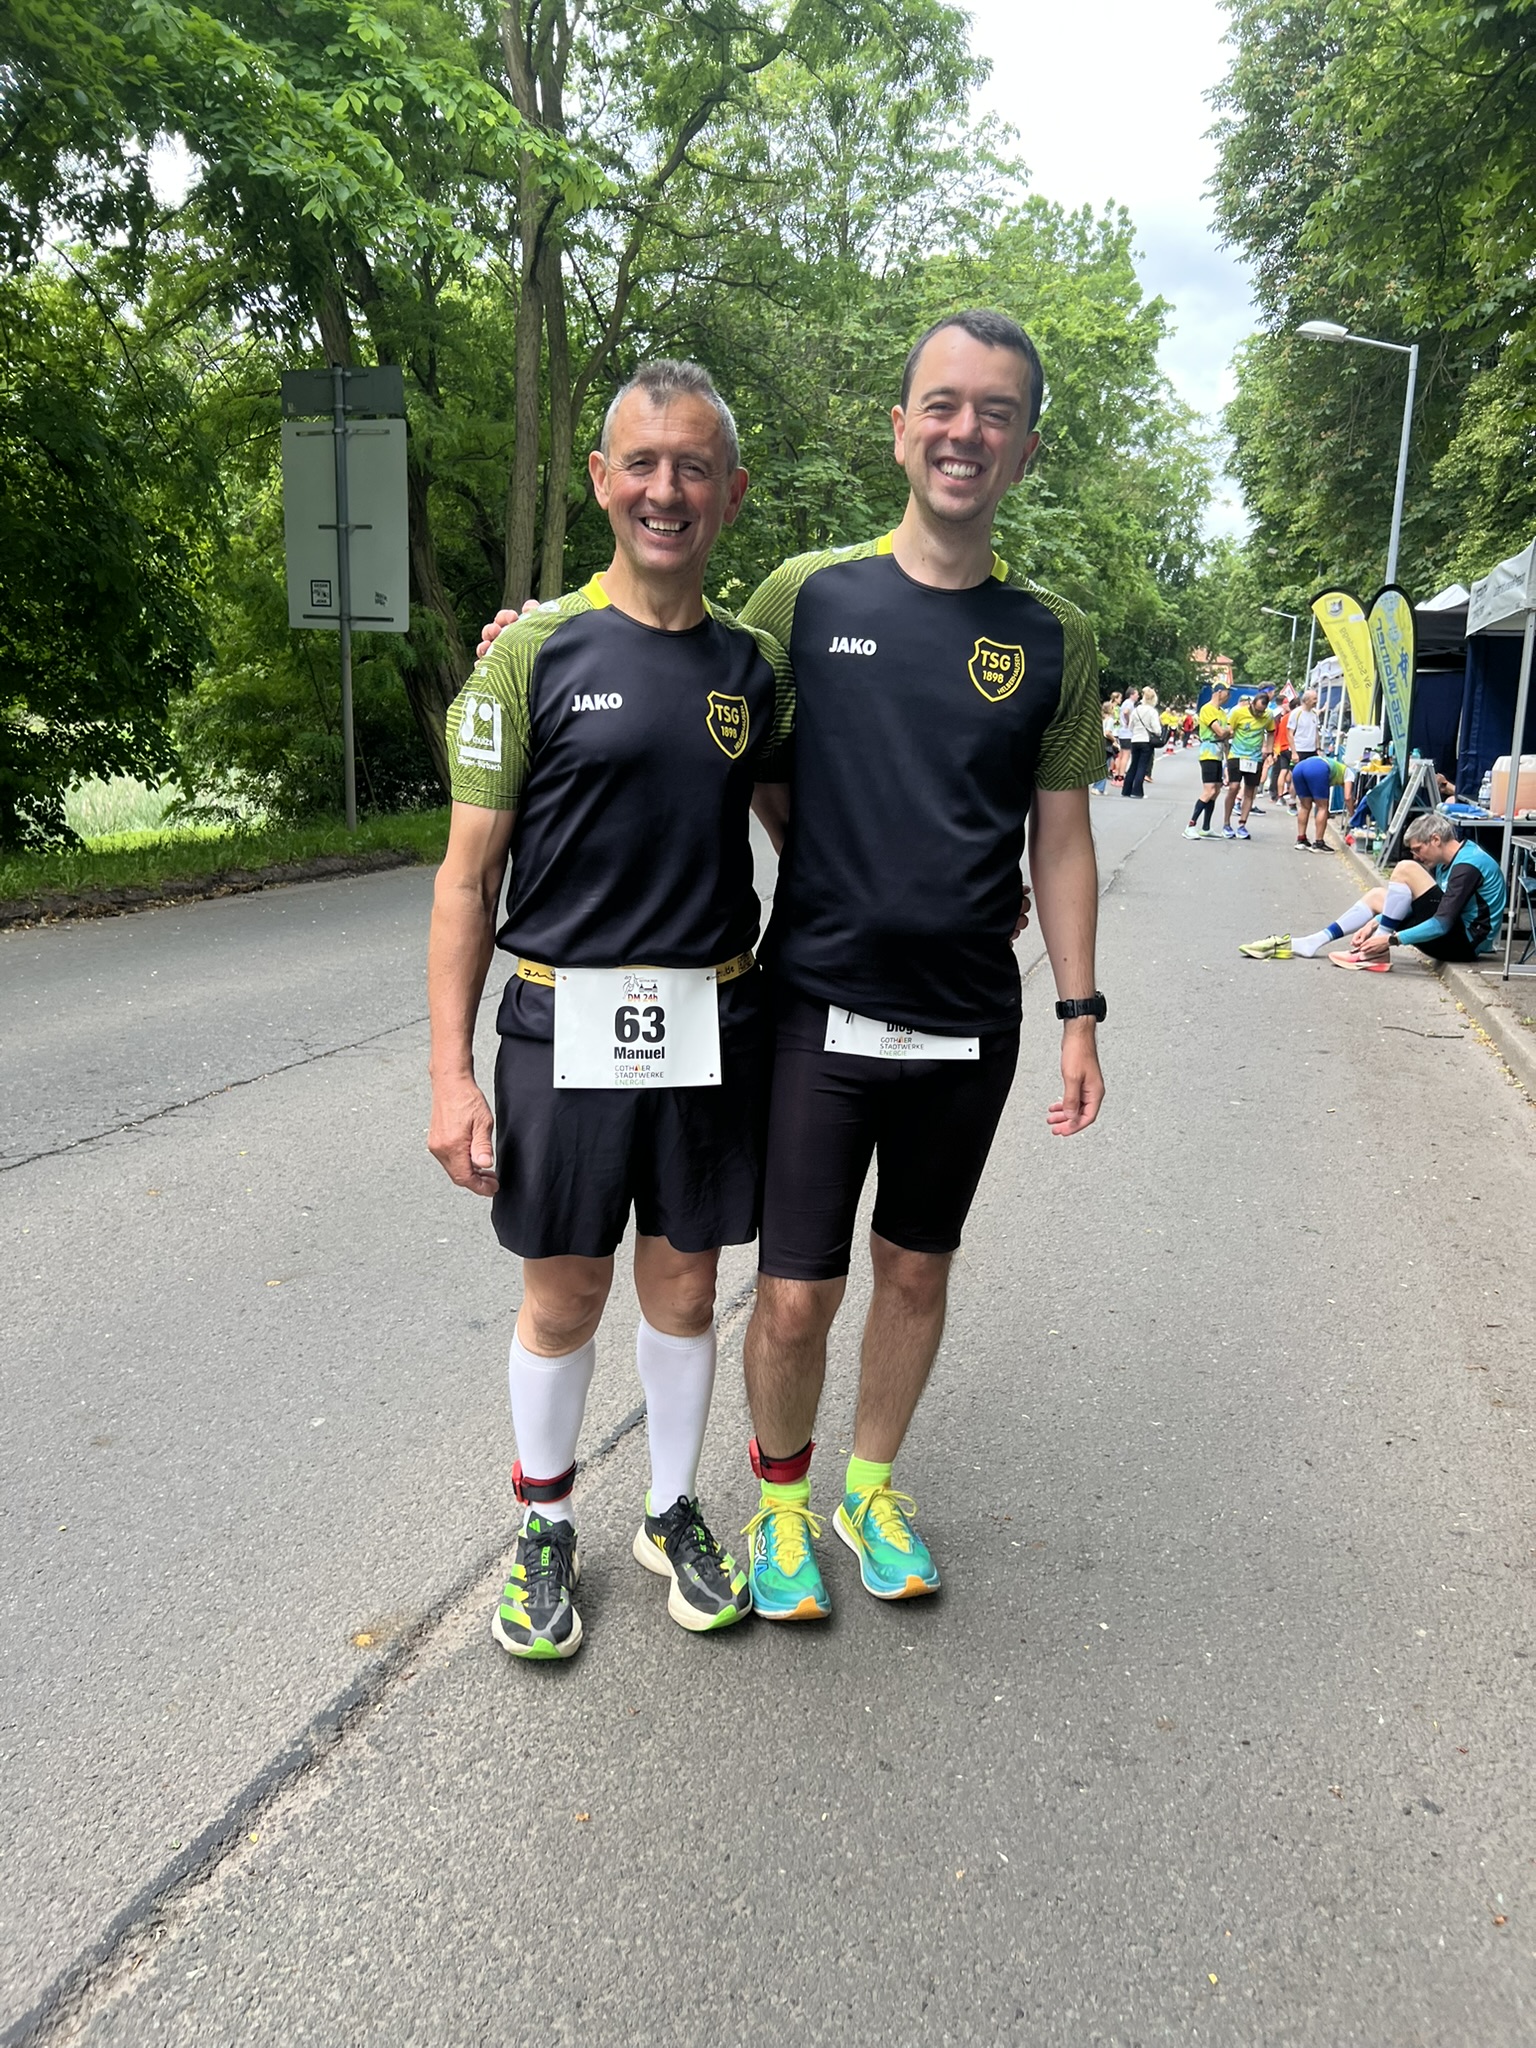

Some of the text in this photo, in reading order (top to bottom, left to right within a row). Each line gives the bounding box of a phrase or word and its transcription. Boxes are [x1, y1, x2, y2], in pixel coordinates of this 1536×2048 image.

[828, 636, 877, 656] JAKO
[980, 650, 1011, 671] TSG
[982, 670, 1004, 684] 1898
[571, 692, 623, 712] JAKO
[715, 704, 740, 725] TSG
[720, 725, 738, 739] 1898
[627, 993, 658, 1002] DM 24h
[614, 1005, 666, 1043] 63
[613, 1046, 666, 1060] Manuel
